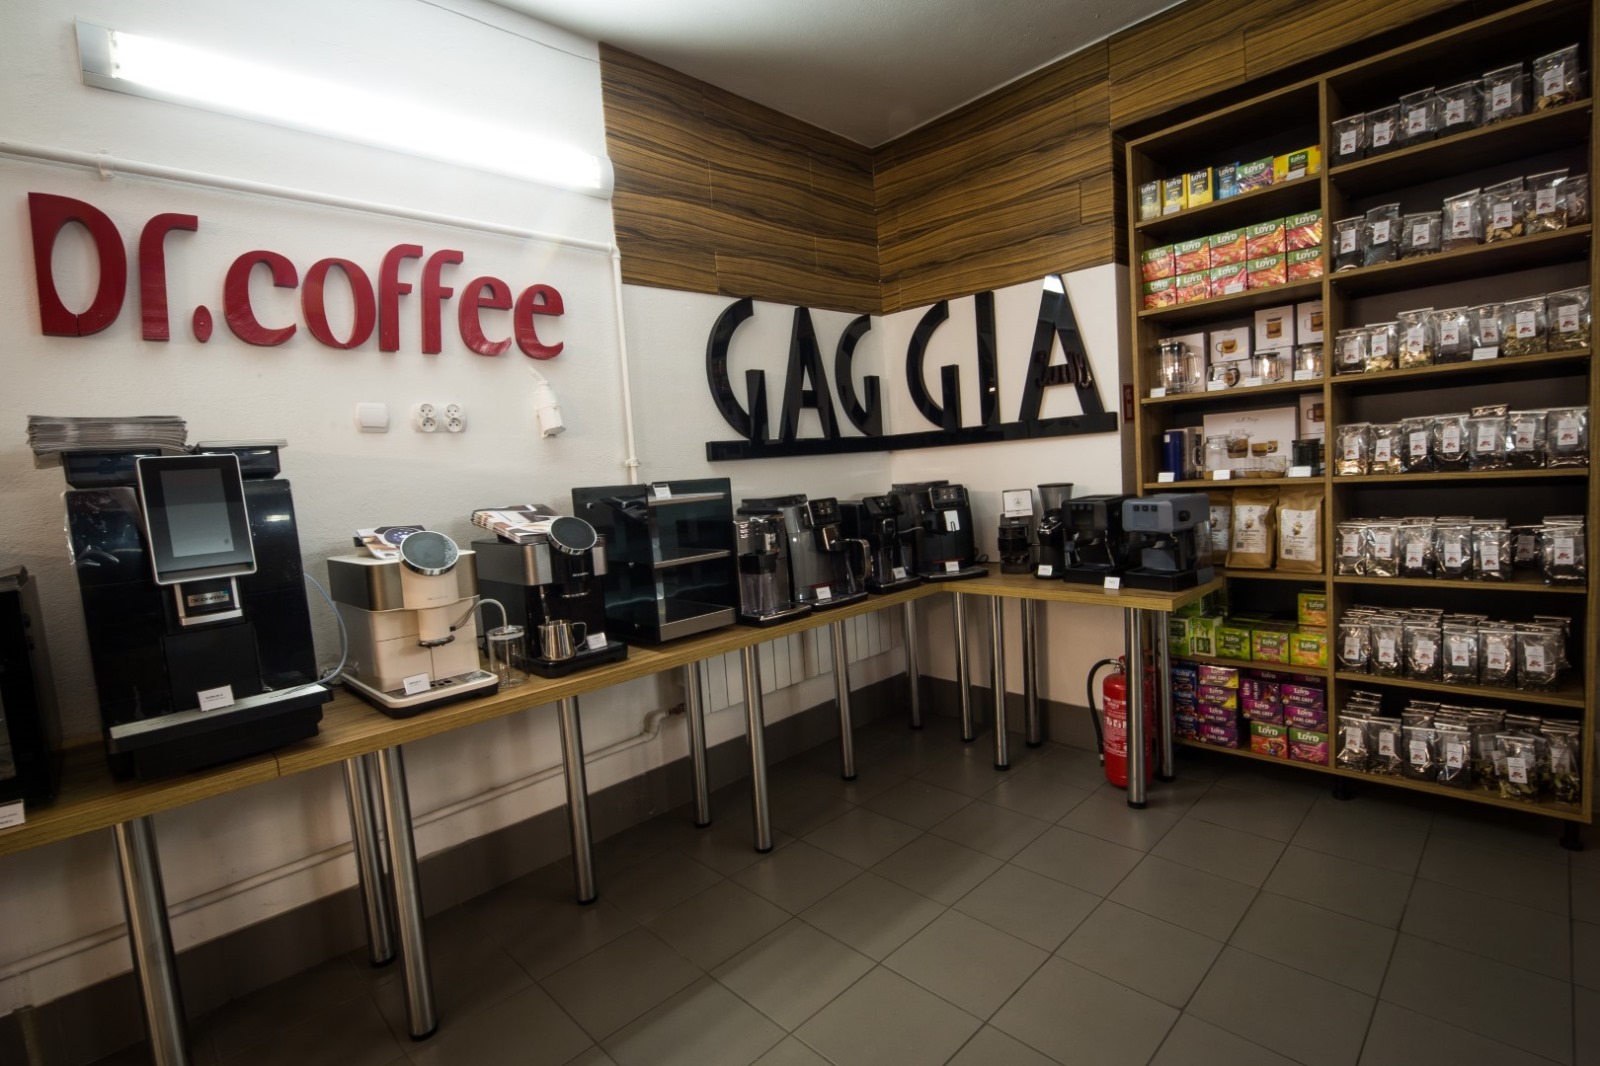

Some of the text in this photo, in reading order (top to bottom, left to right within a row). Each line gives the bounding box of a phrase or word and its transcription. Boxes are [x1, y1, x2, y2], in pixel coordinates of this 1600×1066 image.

[1218, 166, 1235, 177] LOYD
[1244, 162, 1265, 174] LOYD
[1191, 171, 1207, 181] LOYD
[1295, 213, 1317, 225] LOYD
[1254, 223, 1276, 235] LOYD
[1217, 232, 1237, 243] LOYD
[1182, 240, 1201, 251] LOYD
[1148, 248, 1166, 259] LOYD
[1296, 249, 1318, 260] LOYD
[1255, 258, 1276, 269] LOYD
[28, 191, 564, 360] Dr.coffee
[1218, 265, 1238, 276] LOYD
[1183, 273, 1202, 284] LOYD
[706, 274, 1106, 445] GAGGIA
[1258, 725, 1278, 736] LOYD
[1297, 731, 1319, 742] LOYD
